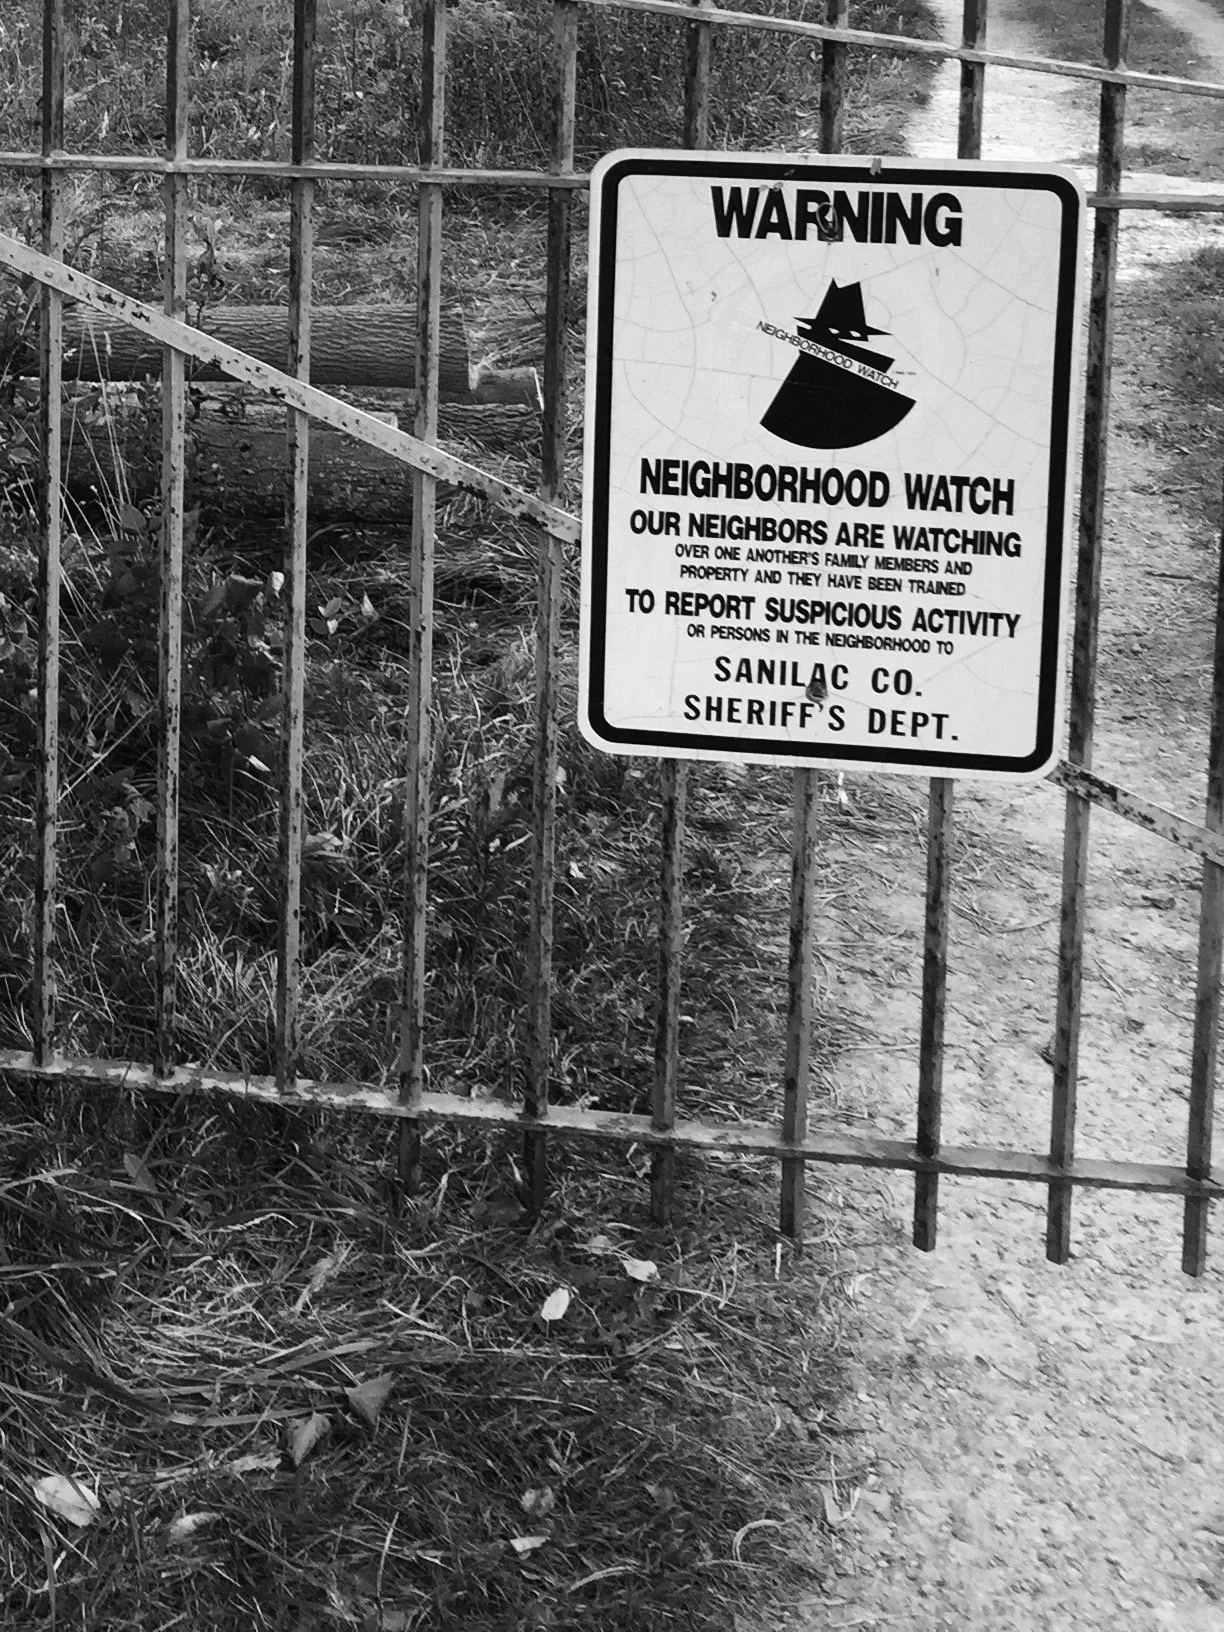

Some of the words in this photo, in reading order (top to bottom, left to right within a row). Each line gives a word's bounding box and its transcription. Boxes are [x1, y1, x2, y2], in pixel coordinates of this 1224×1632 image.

[710, 185, 963, 247] WARNING
[756, 321, 854, 371] NEIGHBORHOOD
[857, 363, 899, 390] WATCH
[639, 457, 890, 509] NEIGHBORHOOD
[904, 472, 1015, 516] WATCH
[630, 509, 681, 537] OUR
[688, 512, 828, 546] NEIGHBORS
[835, 522, 885, 550] ARE
[892, 525, 1022, 558] WATCHING
[675, 543, 710, 561] OVER
[714, 545, 742, 562] ONE
[746, 547, 820, 566] ANOTHER'S
[824, 552, 870, 568] FAMILY
[875, 555, 940, 574] MEMBERS
[944, 559, 973, 576] AND
[679, 565, 748, 582] PROPERTY
[754, 569, 782, 585] AND
[787, 571, 822, 587] THEY
[827, 573, 864, 590] HAVE
[868, 575, 902, 593] BEEN
[907, 578, 966, 597] TRAINED
[625, 588, 655, 614] TO
[665, 590, 756, 621] REPORT
[765, 597, 902, 631] SUSPICIOUS
[911, 607, 1021, 639] ACTIVITY
[687, 624, 706, 639] OR
[710, 625, 770, 643] PERSONS
[776, 629, 789, 643] IN
[794, 631, 821, 646] THE
[825, 632, 931, 653] NEIGHBORHOOD
[936, 640, 954, 655] TO
[714, 656, 849, 691] SANILAC
[871, 667, 923, 698] CO.
[683, 694, 846, 732] SHERIFF'S
[867, 708, 959, 741] DEPT.
